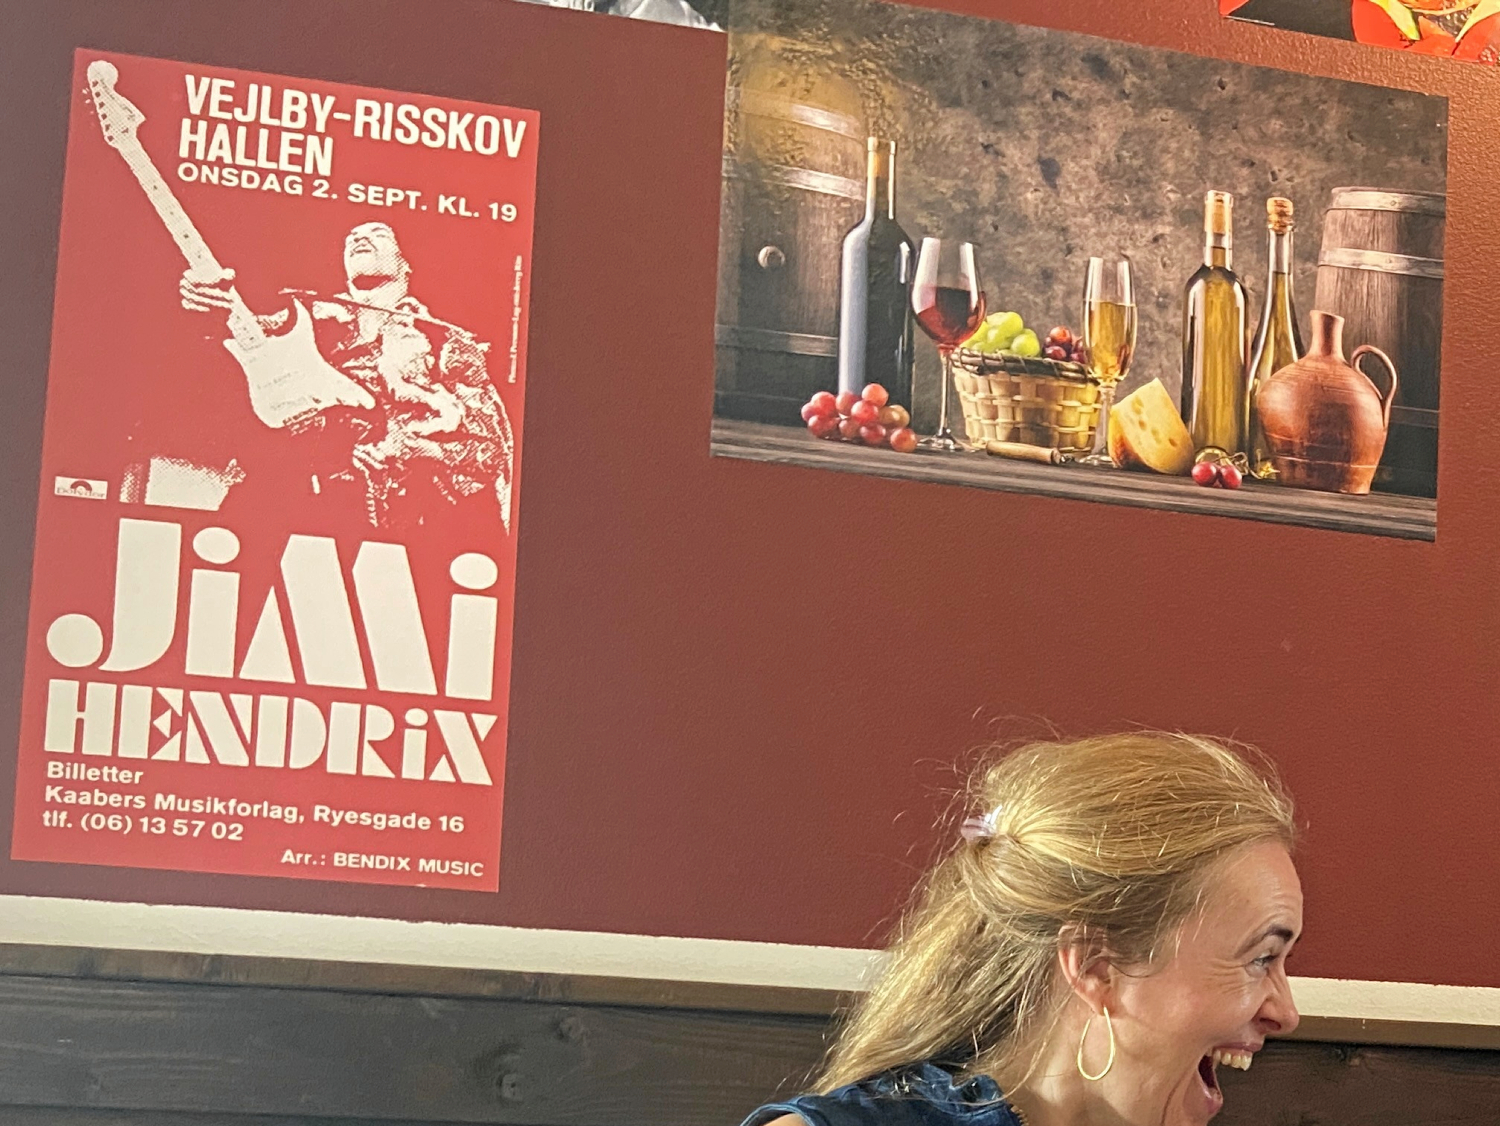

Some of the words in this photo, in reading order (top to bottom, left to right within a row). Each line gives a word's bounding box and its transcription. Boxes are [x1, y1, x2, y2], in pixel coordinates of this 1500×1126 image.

[185, 74, 527, 158] VEJLBY-RISSKOV
[179, 119, 334, 177] HALLEN
[178, 162, 302, 195] ONSDAG
[313, 180, 338, 199] 2.
[348, 184, 428, 210] SEPT.
[438, 195, 480, 217] KL.
[489, 201, 517, 222] 19
[47, 761, 144, 785] Billetter
[42, 810, 73, 829] tlf.
[80, 812, 133, 836] (06)
[141, 817, 168, 836] 13
[173, 819, 203, 838] 57
[211, 822, 244, 841] 02
[45, 786, 146, 810] Kaabers
[154, 794, 305, 824] Musikforlag,
[314, 805, 431, 833] Ryesgade
[439, 815, 465, 834] 16
[281, 849, 327, 867] Arr.:
[333, 852, 411, 873] BENDIX
[418, 857, 484, 878] MUSIC
